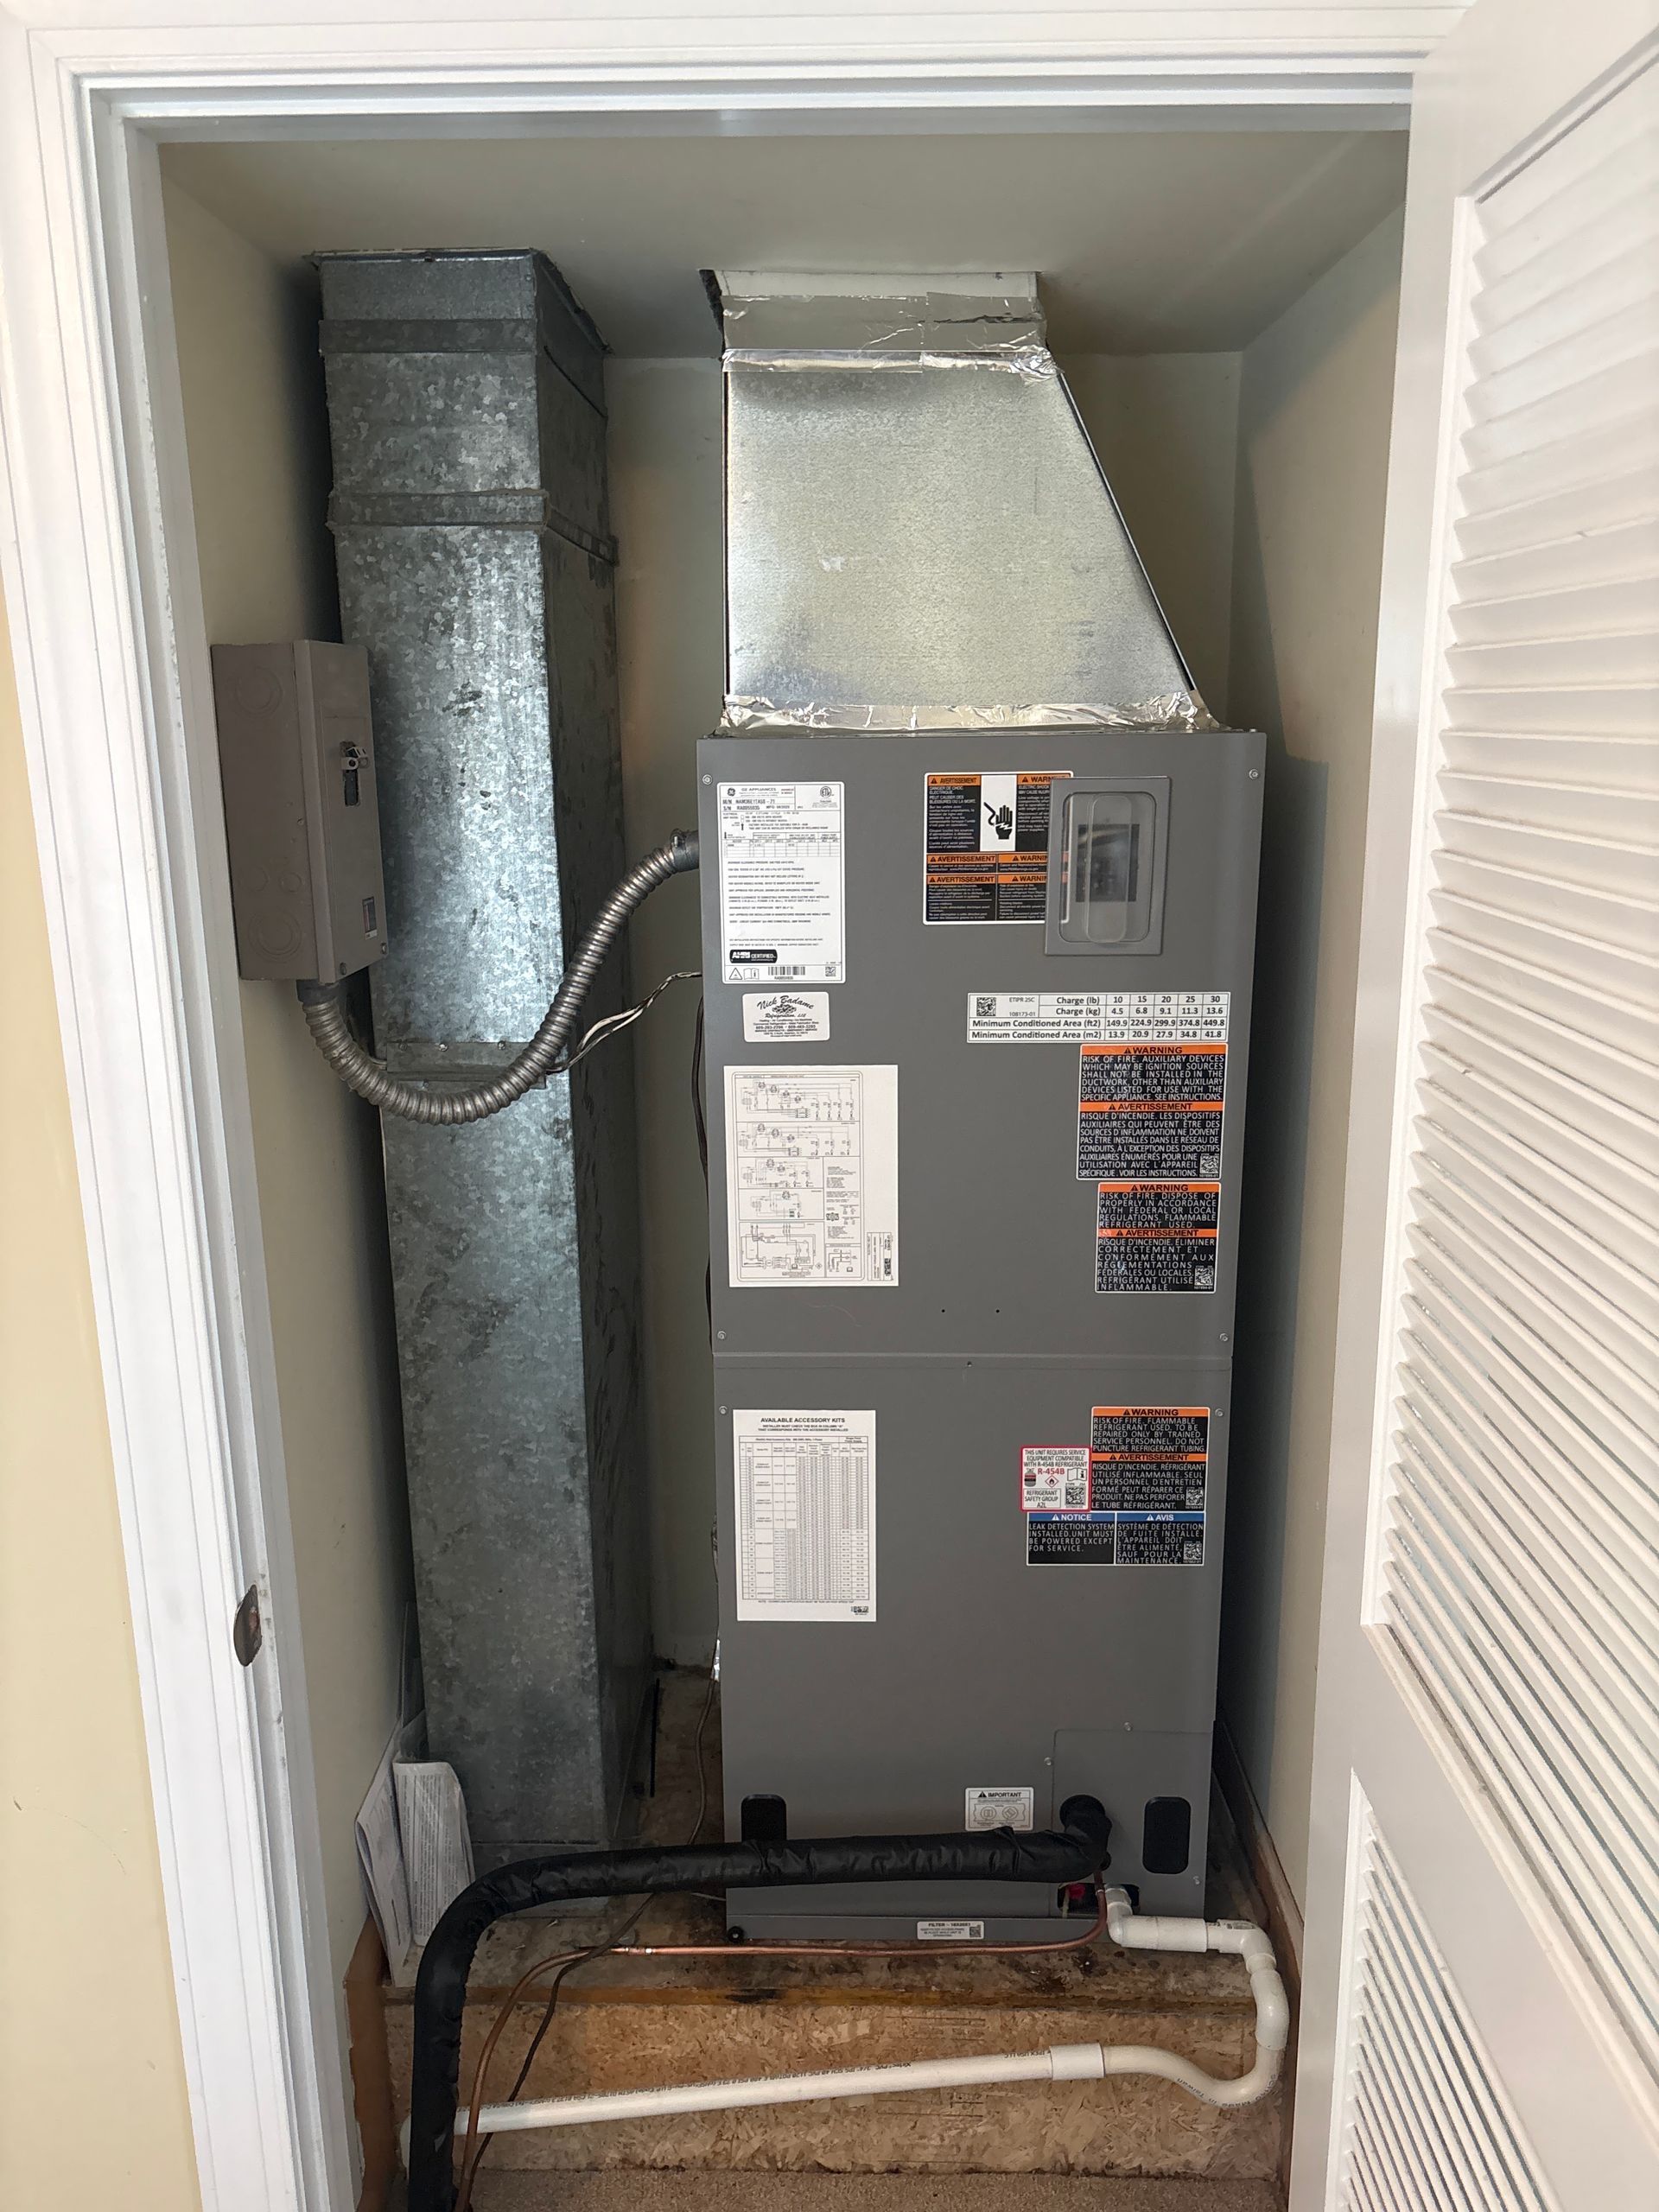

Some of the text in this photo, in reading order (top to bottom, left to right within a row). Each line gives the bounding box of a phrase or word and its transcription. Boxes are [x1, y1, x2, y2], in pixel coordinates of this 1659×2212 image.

[757, 997, 778, 1009] Nick
[1057, 997, 1084, 1006] Charge
[1087, 996, 1100, 1005] (lb)
[1056, 1007, 1083, 1016] Charge
[1086, 1007, 1101, 1016] (kg)
[1084, 1031, 1102, 1039] (m2)
